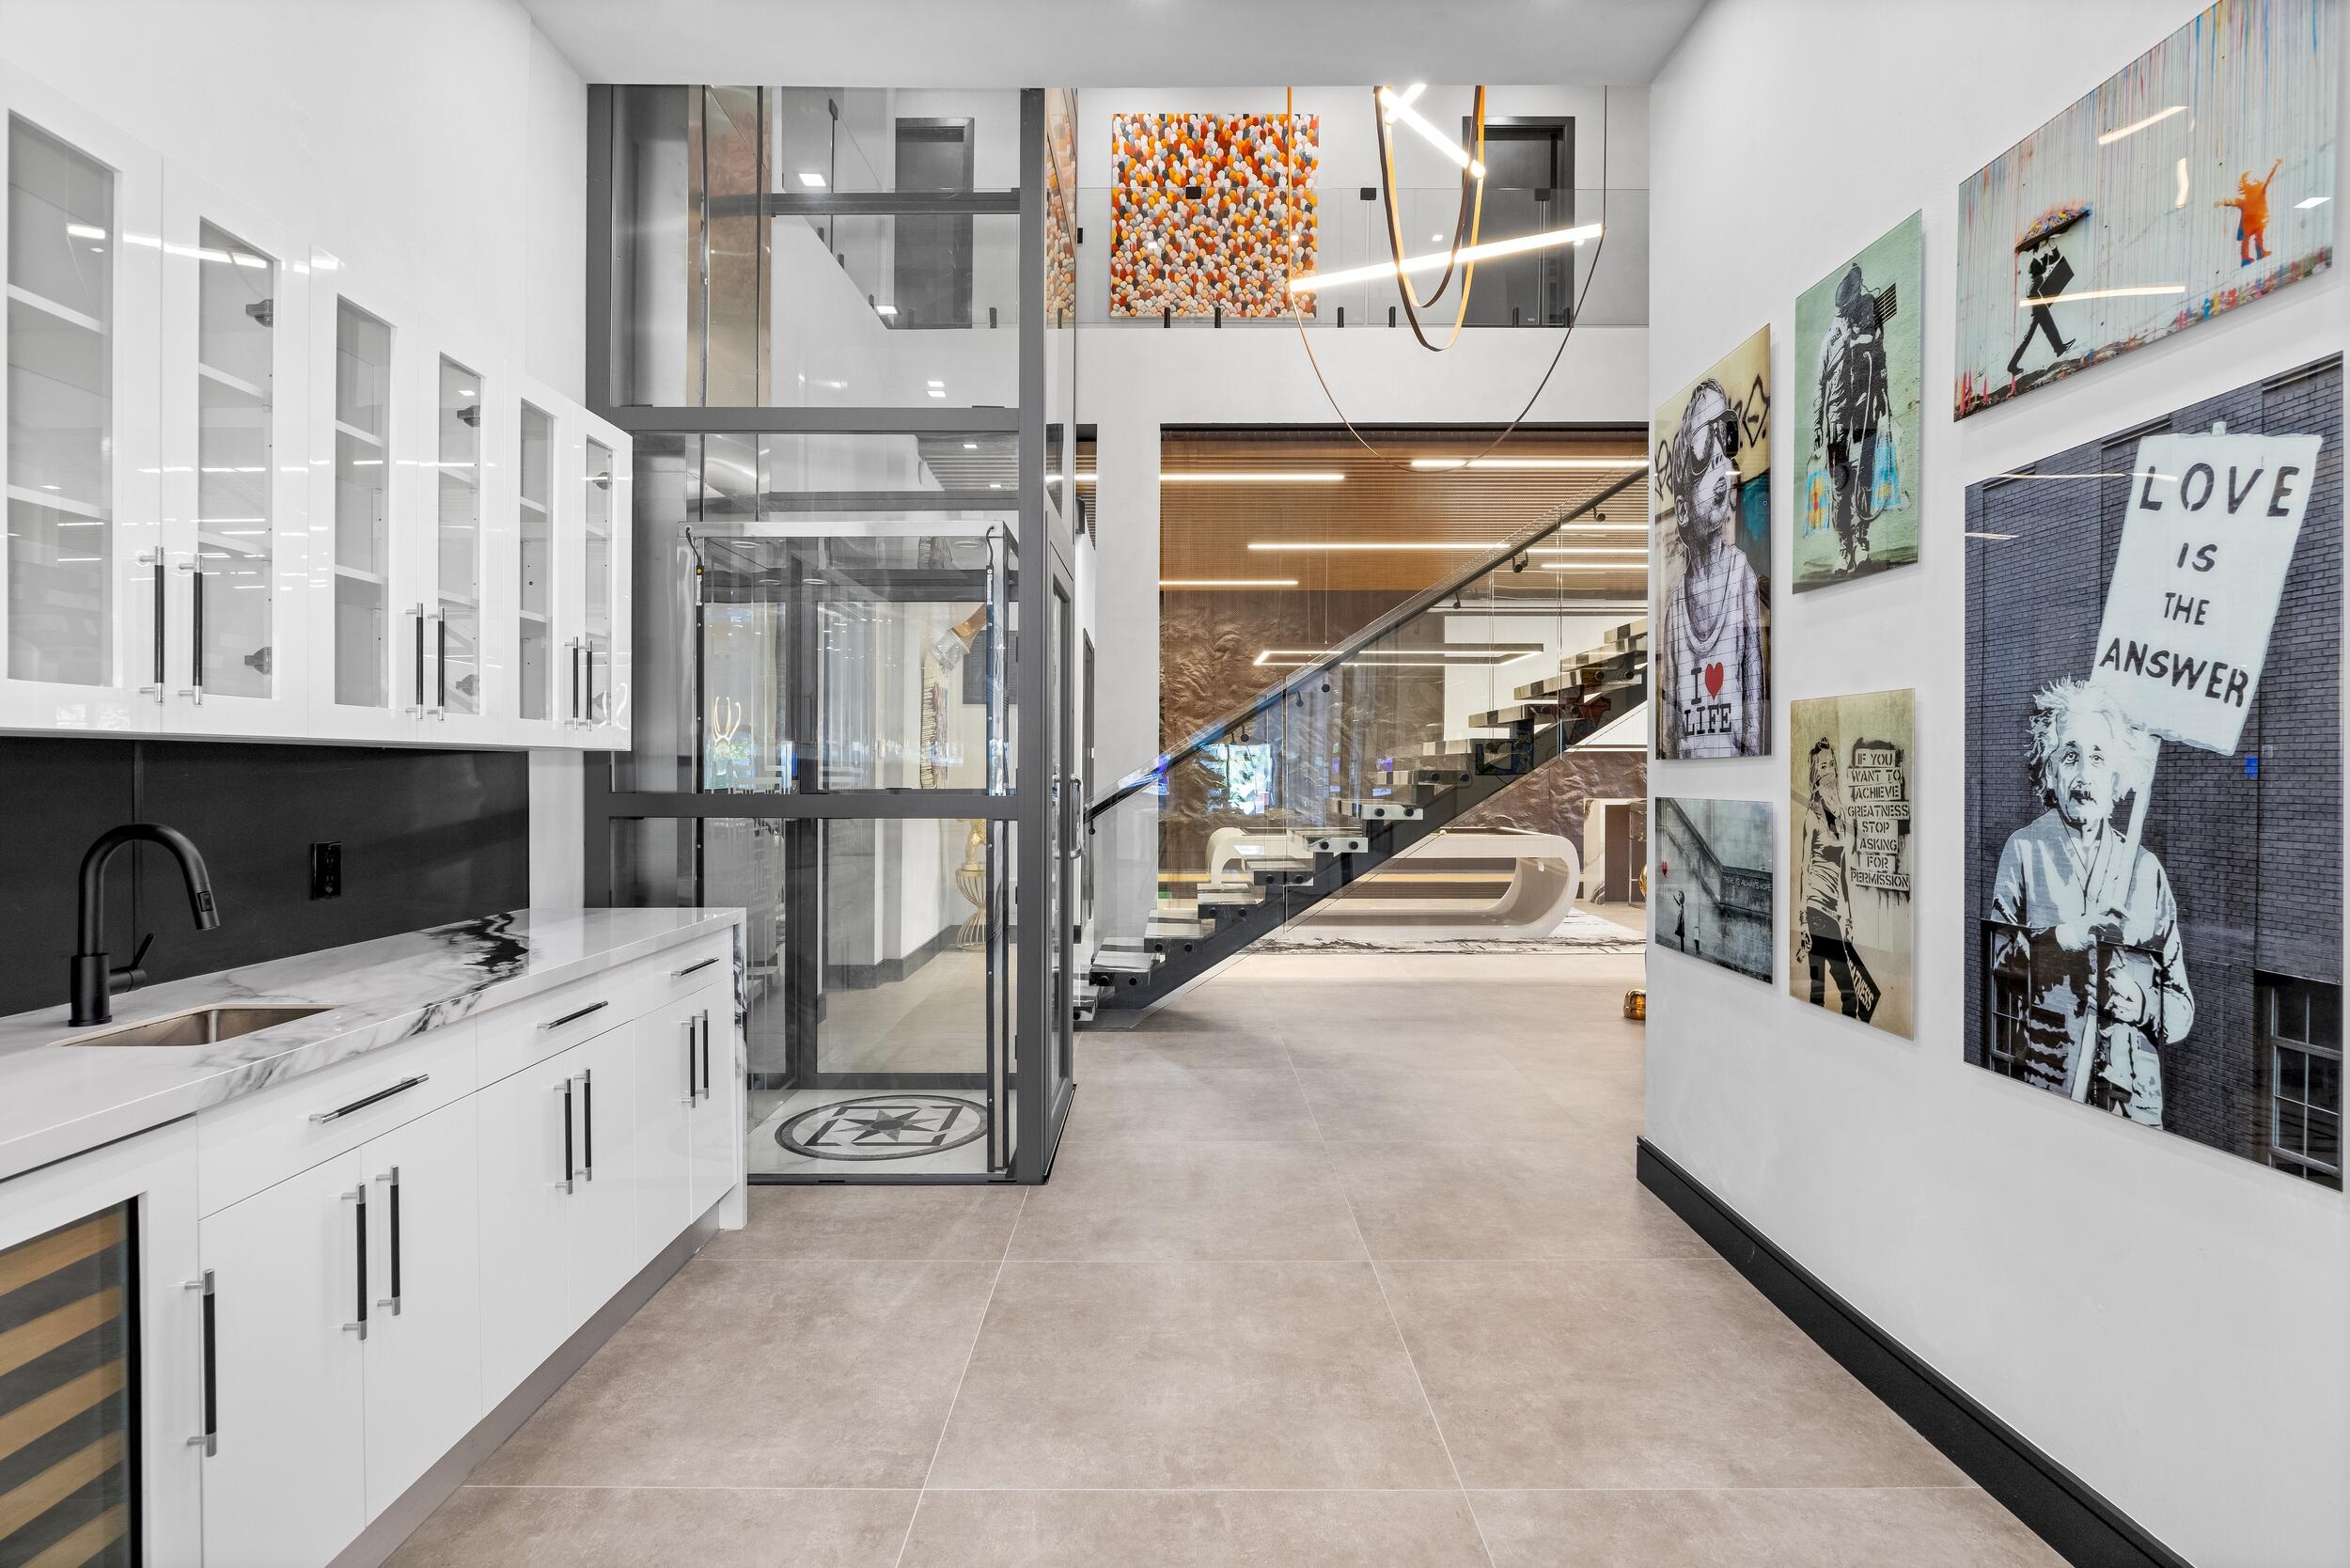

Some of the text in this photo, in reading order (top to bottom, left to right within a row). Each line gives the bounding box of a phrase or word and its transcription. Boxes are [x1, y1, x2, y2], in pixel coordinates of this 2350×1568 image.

[2139, 463, 2300, 517] LOVE
[2176, 542, 2218, 572] IS
[2164, 592, 2210, 626] THE
[2098, 637, 2249, 708] ANSWER
[1691, 667, 1701, 705] I
[1684, 703, 1732, 737] LIFE
[1857, 752, 1893, 766] IF YOU
[1851, 769, 1902, 783] WANT TO
[1856, 785, 1900, 800] ACHIEVE
[1847, 805, 1909, 818] GREATNESS
[1862, 821, 1890, 834] STOP
[1859, 838, 1898, 852] ASKING
[1867, 855, 1888, 870] FOR
[1850, 870, 1909, 888] PERMISSION
